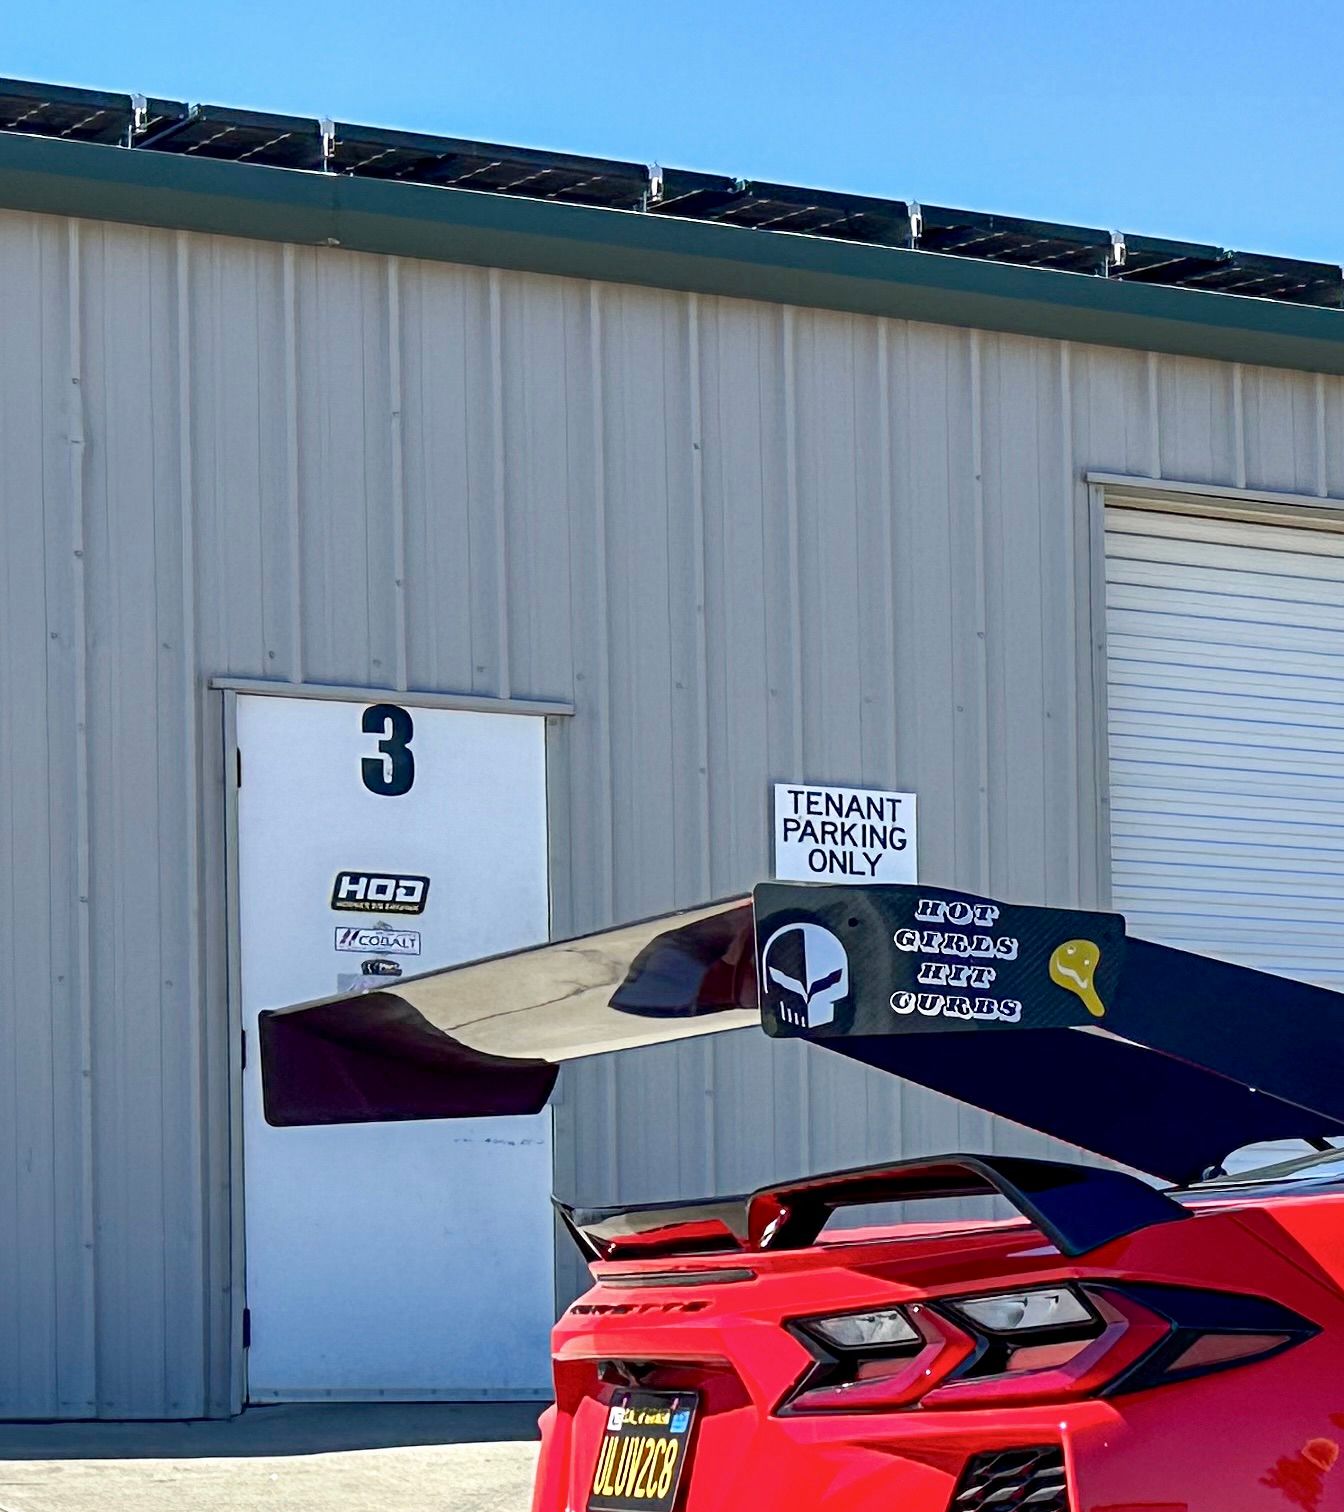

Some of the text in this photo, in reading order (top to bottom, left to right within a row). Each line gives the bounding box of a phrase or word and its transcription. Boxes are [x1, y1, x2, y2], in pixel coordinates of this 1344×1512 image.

[361, 703, 416, 797] 3
[787, 790, 902, 822] TENANT
[783, 817, 907, 851] PARKING
[808, 848, 883, 876] ONLY
[914, 899, 1000, 927] HOT
[893, 928, 1019, 961] GIRLS
[917, 962, 997, 989] HIT
[889, 990, 1023, 1023] CURBS
[592, 1435, 680, 1499] ULUV2C8
